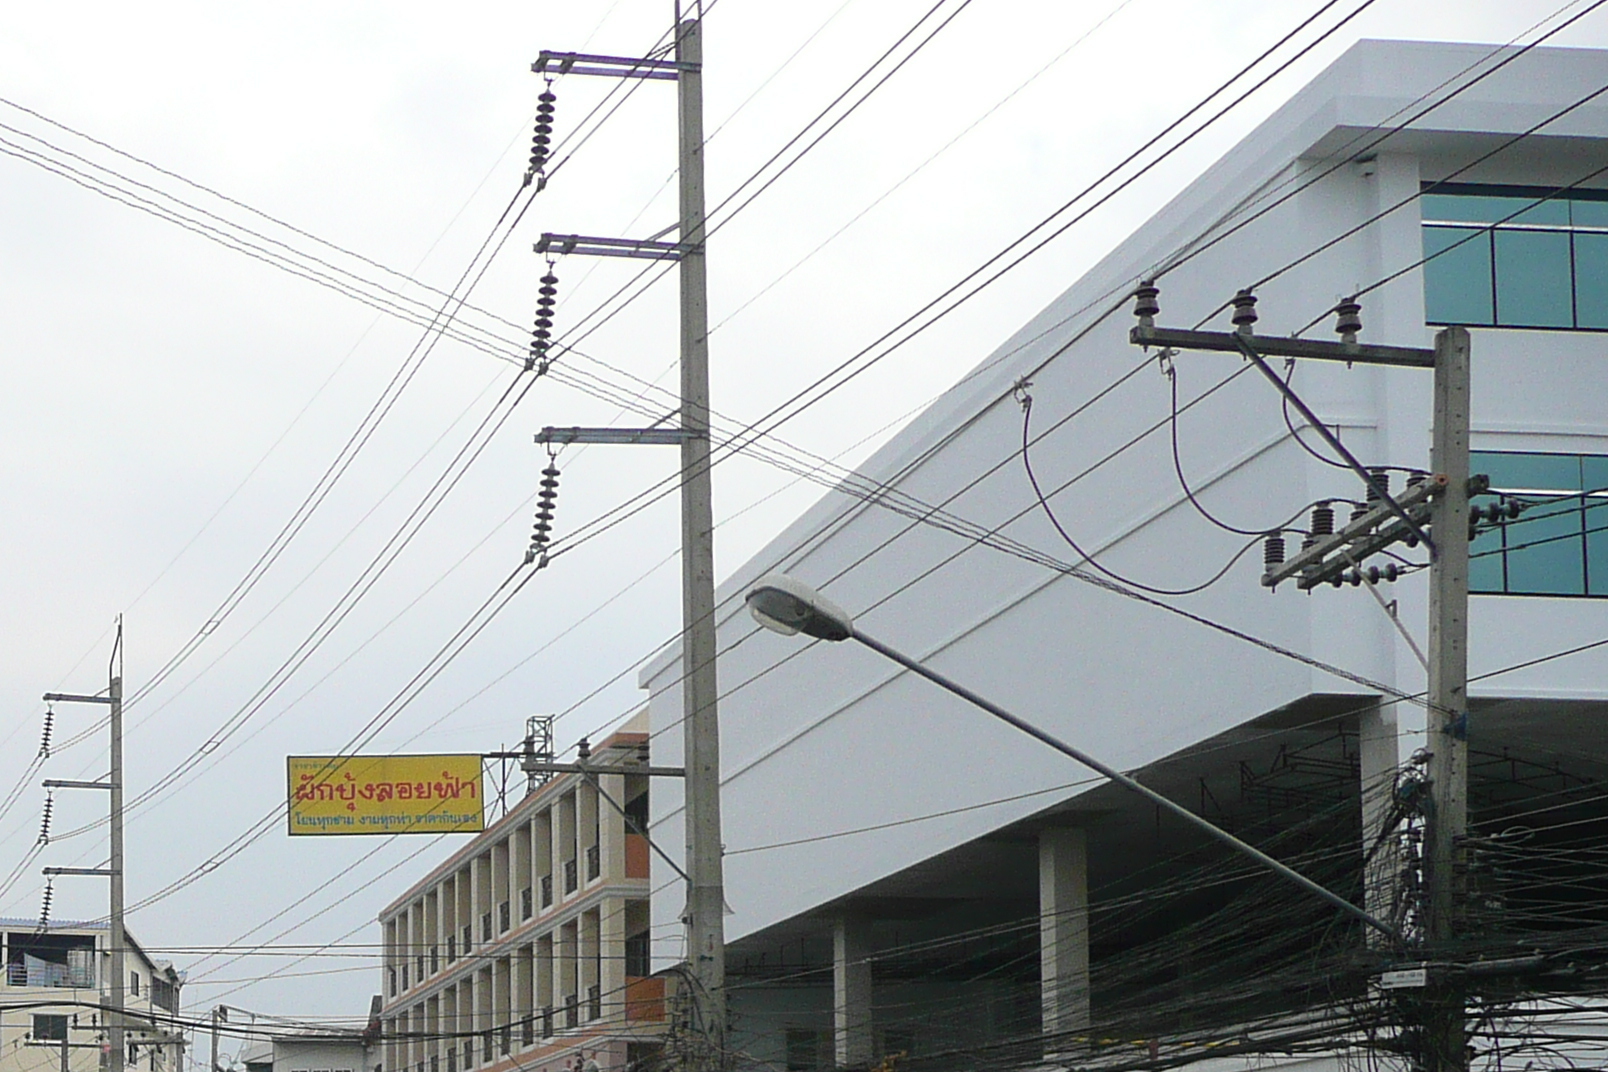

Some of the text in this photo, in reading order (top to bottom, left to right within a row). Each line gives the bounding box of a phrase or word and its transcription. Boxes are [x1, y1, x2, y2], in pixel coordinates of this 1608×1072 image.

[296, 771, 476, 812] ผักบุ้งลอยฟ้า
